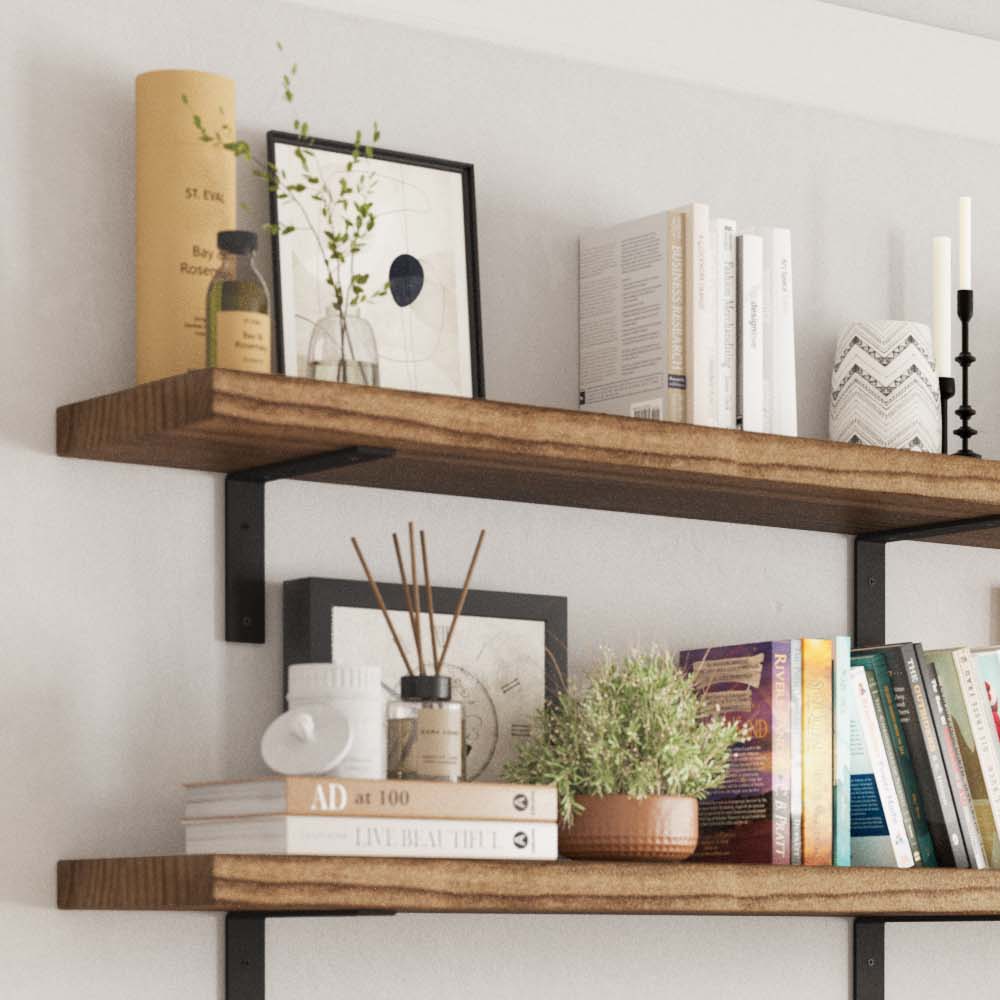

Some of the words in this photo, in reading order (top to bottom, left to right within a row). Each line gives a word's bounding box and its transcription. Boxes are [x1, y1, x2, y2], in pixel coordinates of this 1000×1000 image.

[192, 245, 214, 260] Bay
[907, 657, 919, 683] THE
[310, 783, 348, 811] AD
[353, 790, 371, 805] at
[378, 790, 409, 806] 100
[354, 827, 394, 847] LIVE
